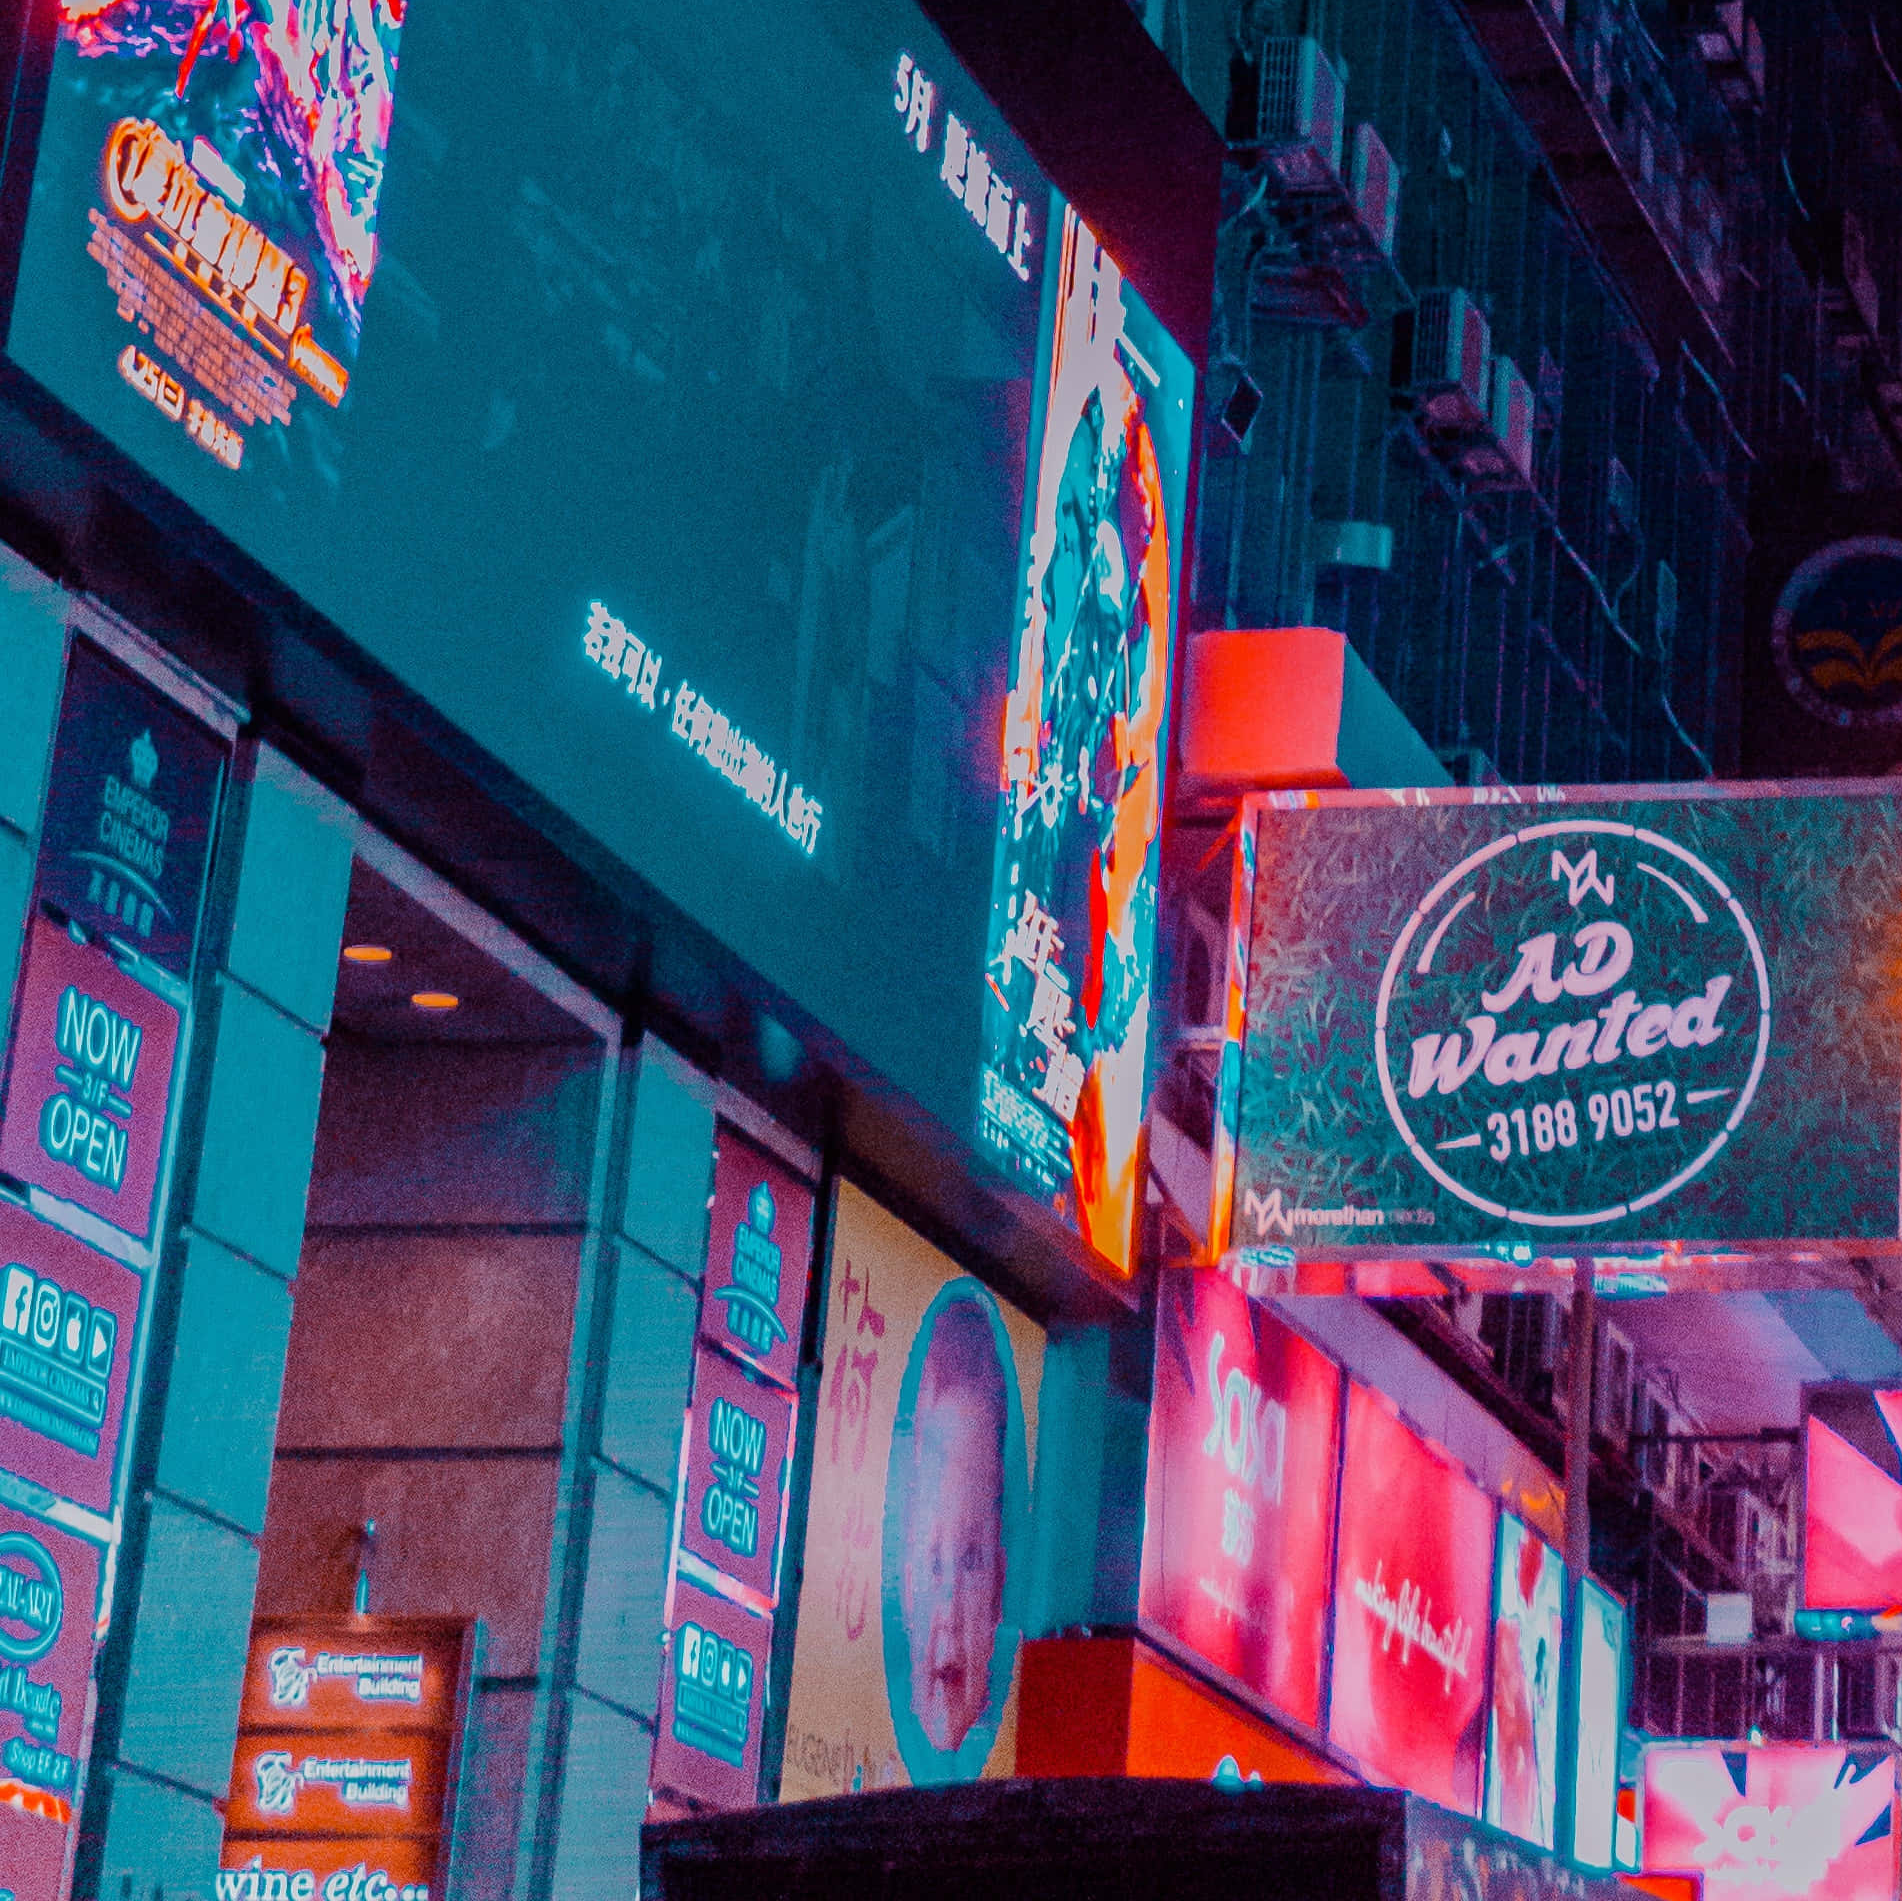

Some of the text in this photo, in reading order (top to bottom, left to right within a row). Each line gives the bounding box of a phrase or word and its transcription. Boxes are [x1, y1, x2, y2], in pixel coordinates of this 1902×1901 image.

[100, 810, 164, 880] CINEMAS
[102, 775, 169, 845] EMPEROR
[1482, 921, 1634, 1013] AD
[61, 988, 141, 1086] NOW
[1407, 974, 1733, 1099] Wanted
[49, 1097, 127, 1186] OPEN
[1487, 1080, 1681, 1162] 3188 9052
[713, 1399, 766, 1473] NOW
[706, 1486, 757, 1553] OPEN
[316, 1653, 423, 1675] Entertainment
[358, 1677, 420, 1703] Building
[303, 1757, 411, 1782] Entertainment
[344, 1783, 409, 1808] Building
[215, 1855, 315, 1901] wine
